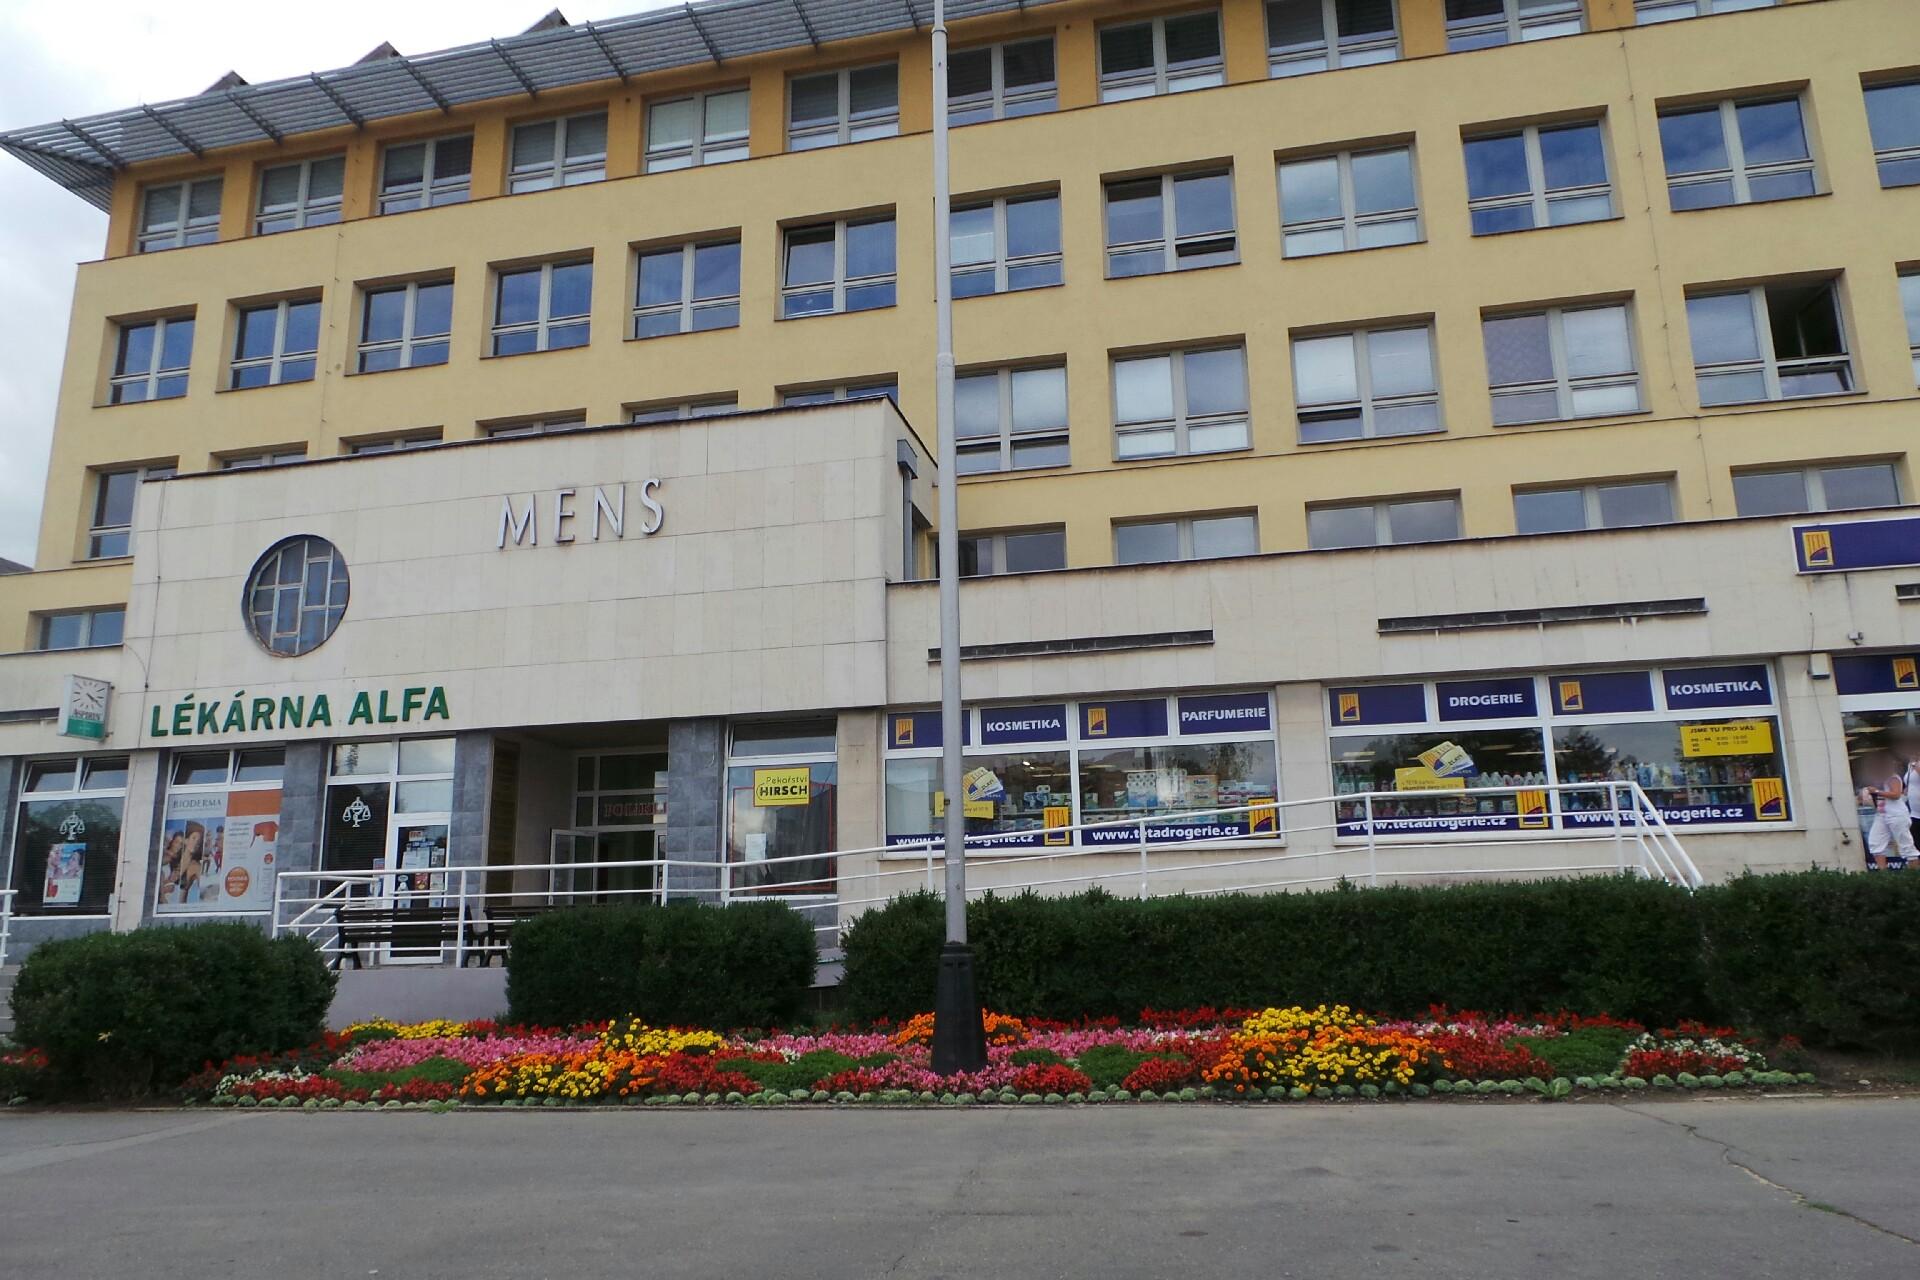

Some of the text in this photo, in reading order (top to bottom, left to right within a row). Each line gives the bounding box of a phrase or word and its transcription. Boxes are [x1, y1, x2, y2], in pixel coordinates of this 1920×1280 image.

[497, 478, 664, 549] MENS
[1670, 680, 1762, 696] KOSMETIKA
[1449, 693, 1523, 707] DROGERIE
[151, 686, 450, 737] LÉKÁRNA ALFA
[1181, 707, 1266, 722] PARFUMERIE
[986, 718, 1061, 732] KOSMETIKA
[760, 785, 808, 797] HIRSCH
[173, 799, 221, 808] BIODERMA
[1092, 825, 1240, 841] www.ttadrogerie.cz
